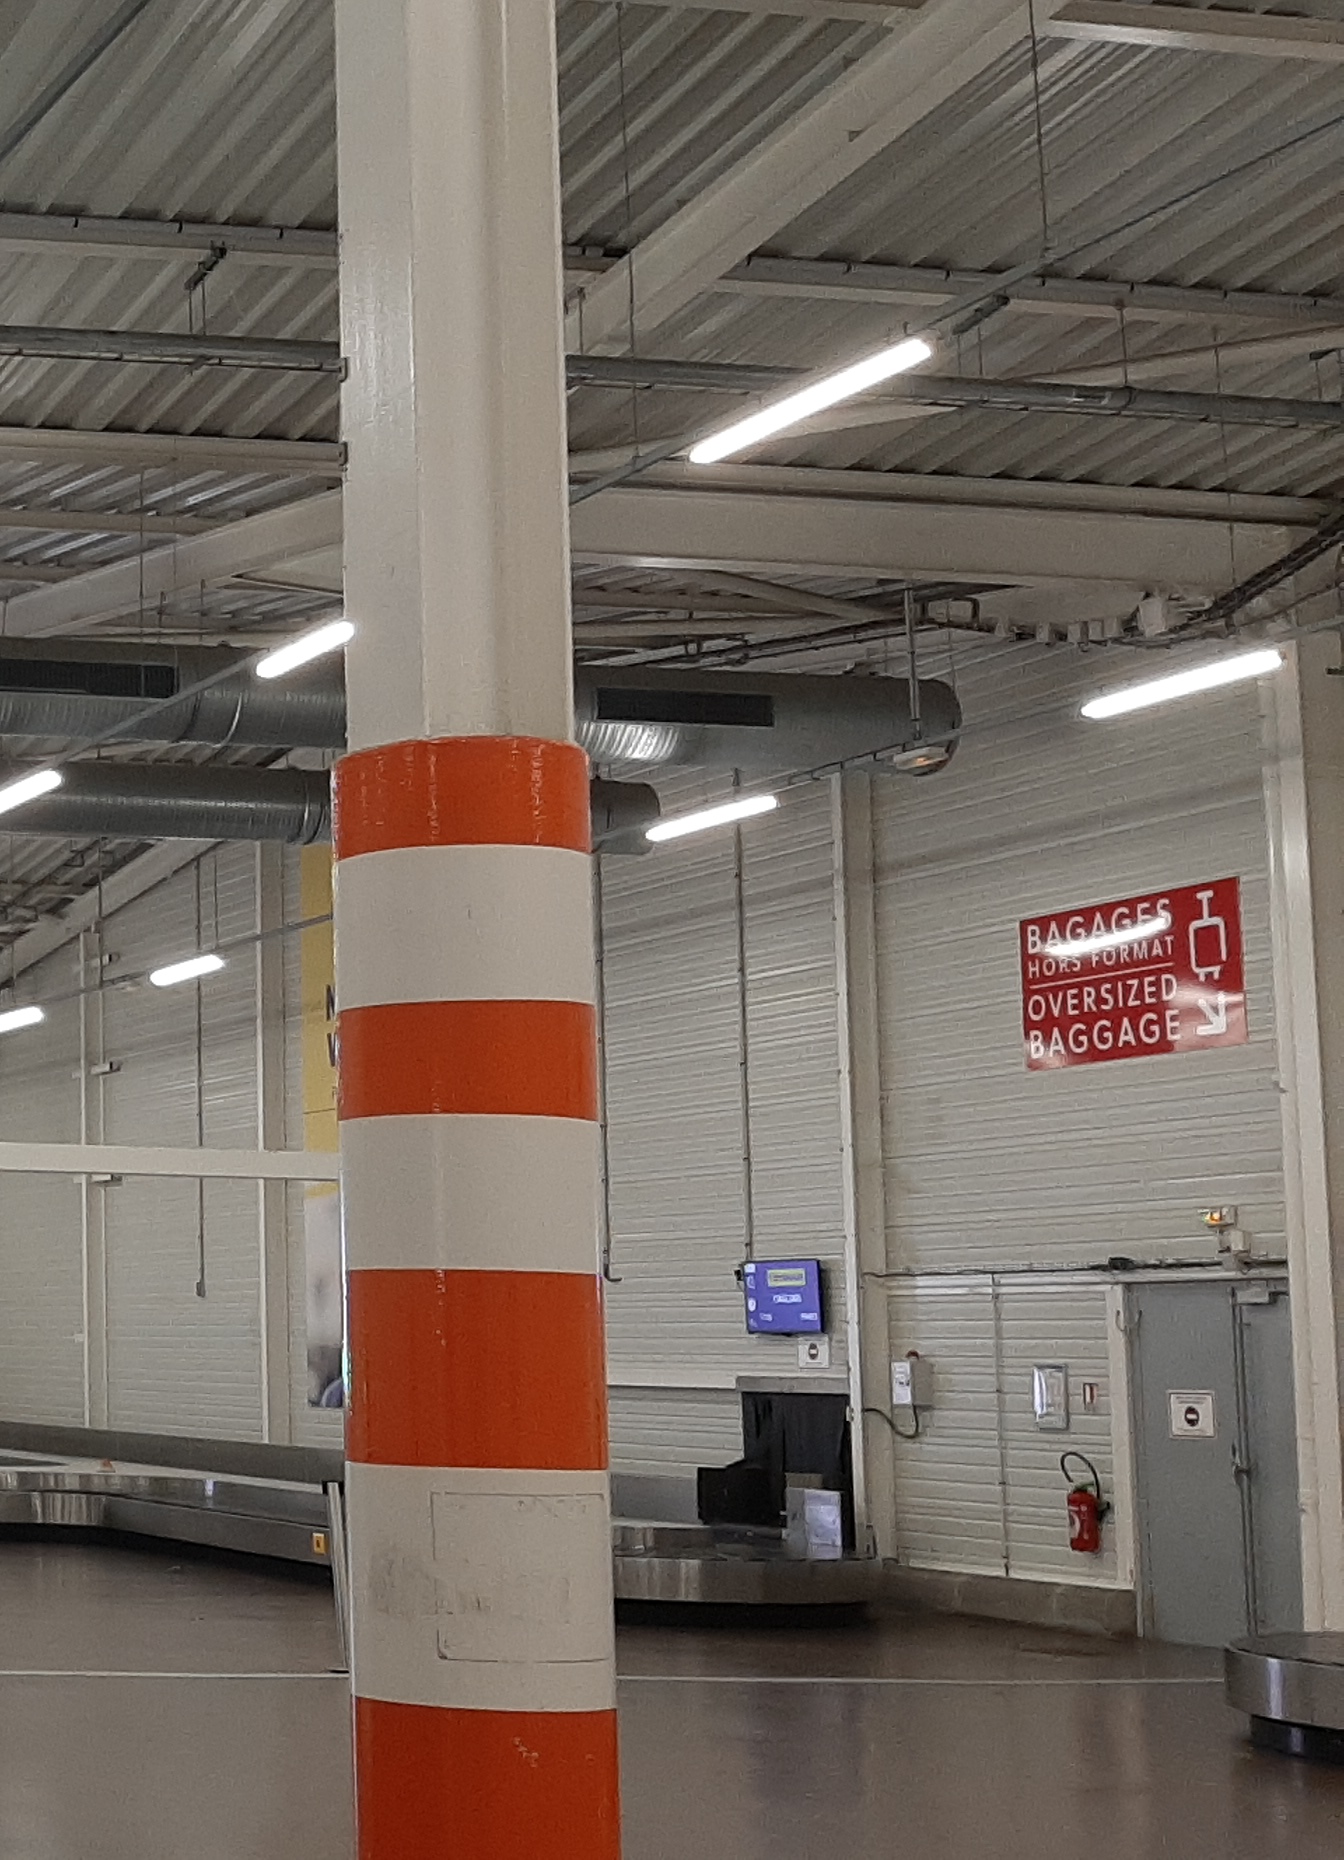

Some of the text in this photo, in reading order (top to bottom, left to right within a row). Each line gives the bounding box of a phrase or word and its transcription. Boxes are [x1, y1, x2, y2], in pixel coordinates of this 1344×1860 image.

[1026, 898, 1173, 955] BAGAGES
[1028, 955, 1082, 979] HORS
[1091, 935, 1175, 969] FORMAT
[1027, 973, 1178, 1021] OVERSIZED
[1029, 1009, 1182, 1059] BAGGAGE
